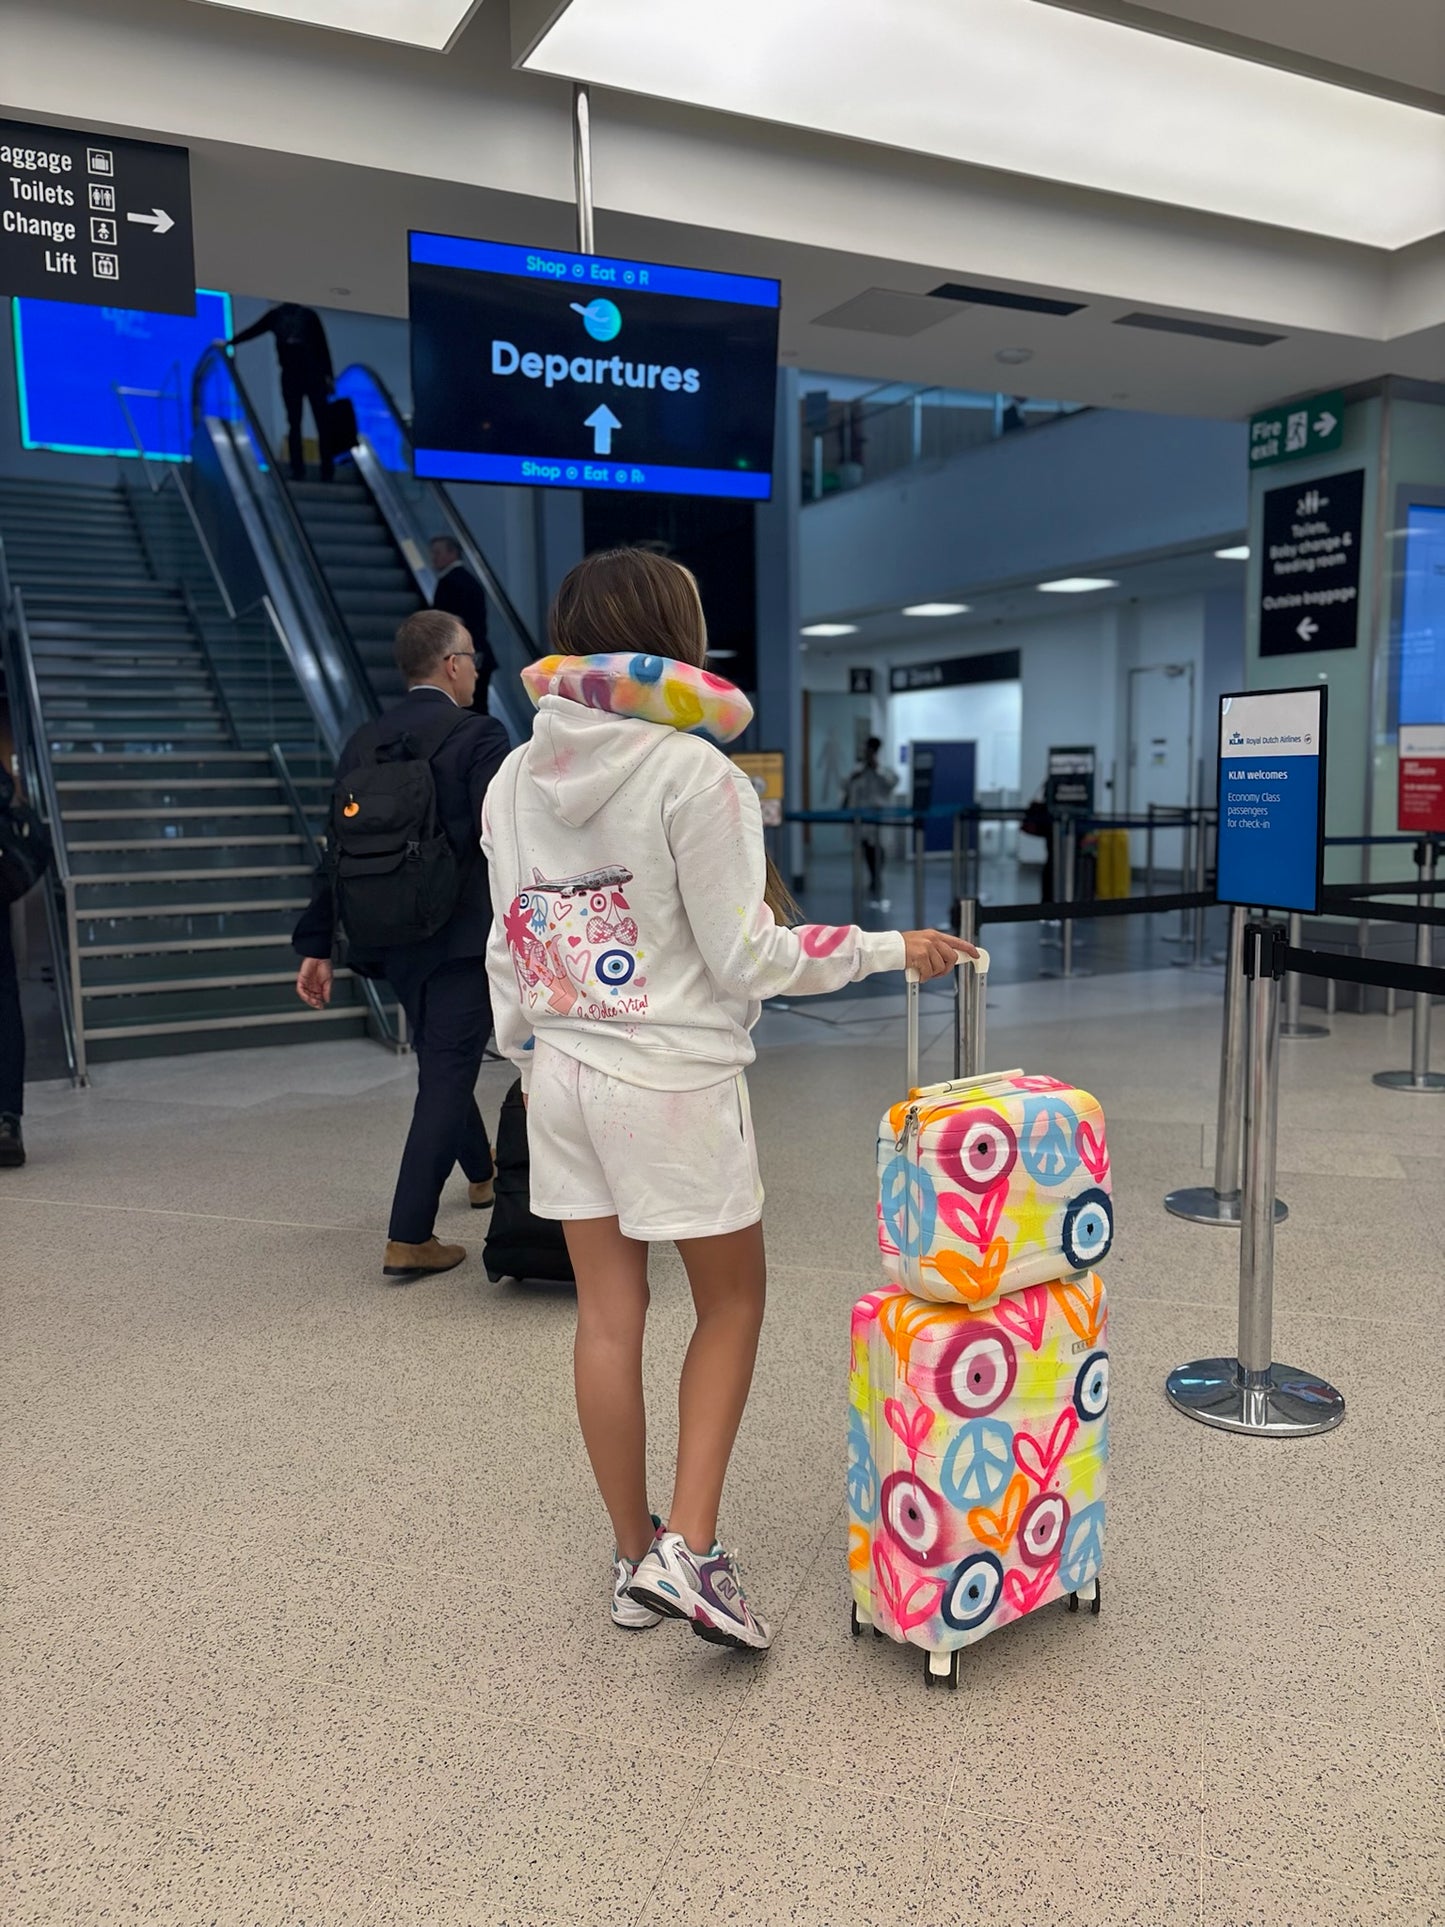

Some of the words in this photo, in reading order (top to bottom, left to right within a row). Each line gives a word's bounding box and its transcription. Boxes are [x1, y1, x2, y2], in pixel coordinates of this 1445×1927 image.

[9, 177, 74, 206] Toilets
[3, 210, 76, 242] Change
[45, 250, 77, 275] Lift
[526, 255, 567, 278] Shop
[590, 263, 616, 281] Eat
[491, 340, 700, 393] Departures
[1252, 420, 1282, 441] Fire
[1251, 438, 1279, 461] exit
[521, 461, 560, 481] Shop
[584, 465, 609, 481] Eat
[1246, 737, 1261, 746] Royal
[1262, 736, 1279, 744] Dutch
[1280, 734, 1302, 744] Airlines
[1228, 770, 1245, 780] KLM
[1247, 769, 1288, 780] welcomes
[1227, 792, 1260, 803] Economy
[1261, 792, 1281, 802] Class
[1227, 806, 1268, 817] passengers
[1227, 818, 1237, 828] for
[1238, 818, 1271, 829] check-in
